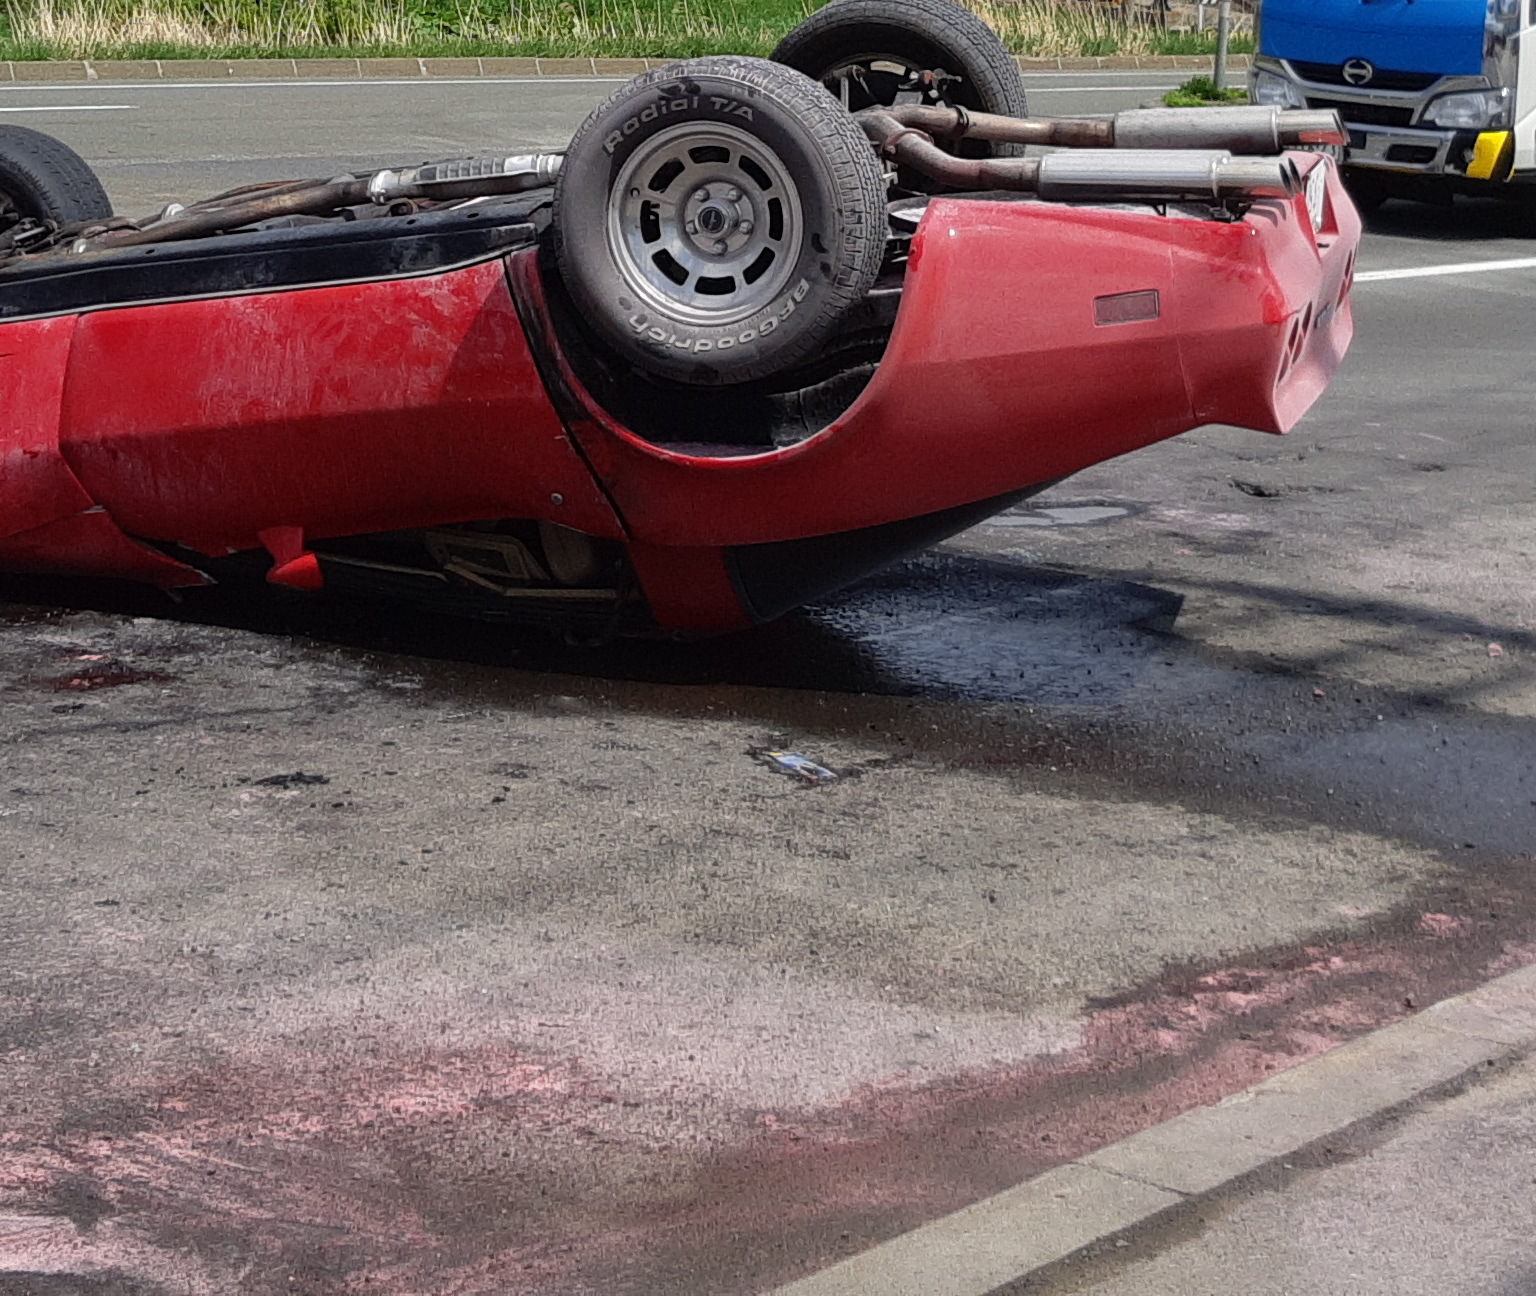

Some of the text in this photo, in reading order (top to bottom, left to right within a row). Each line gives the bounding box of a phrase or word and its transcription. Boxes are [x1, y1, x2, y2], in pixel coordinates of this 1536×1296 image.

[602, 96, 754, 155] Radial T/A
[628, 277, 811, 355] BFGoodrich
